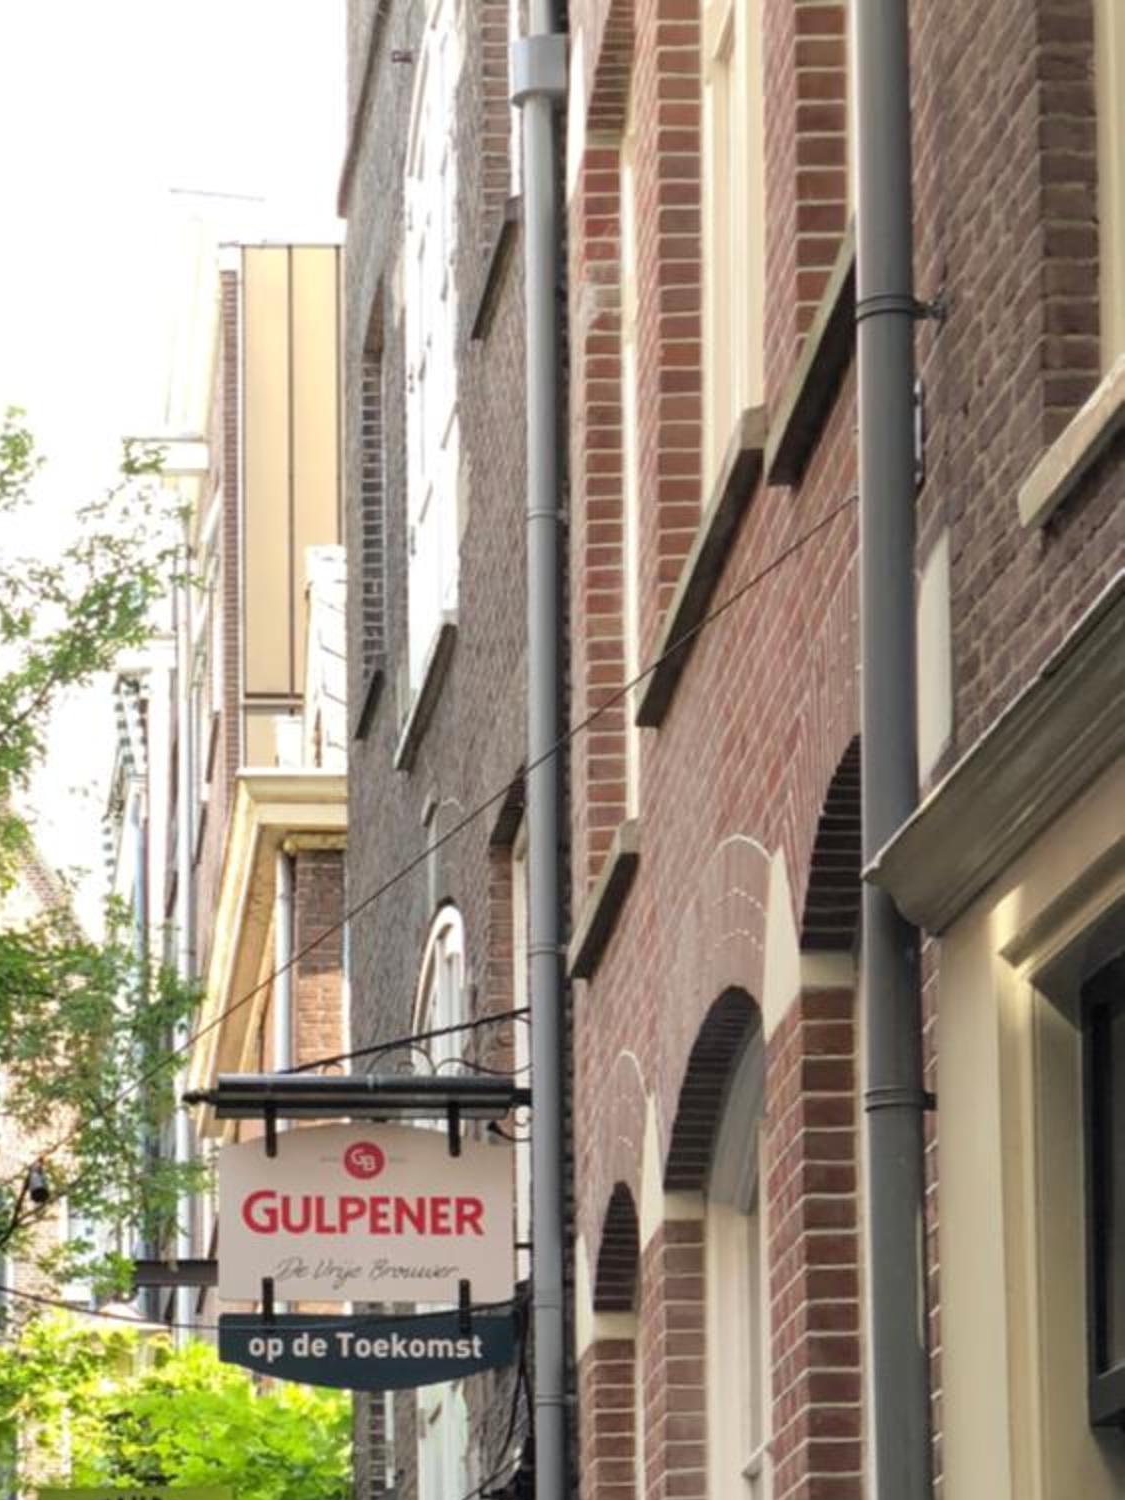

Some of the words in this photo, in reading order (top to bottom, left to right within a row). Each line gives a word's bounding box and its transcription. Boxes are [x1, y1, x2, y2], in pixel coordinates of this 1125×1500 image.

[242, 1189, 485, 1236] GULPENER
[275, 1256, 309, 1281] De
[369, 1257, 460, 1281] Brouwer
[248, 1335, 283, 1363] op
[292, 1333, 328, 1359] de
[336, 1332, 484, 1359] Toekomst
